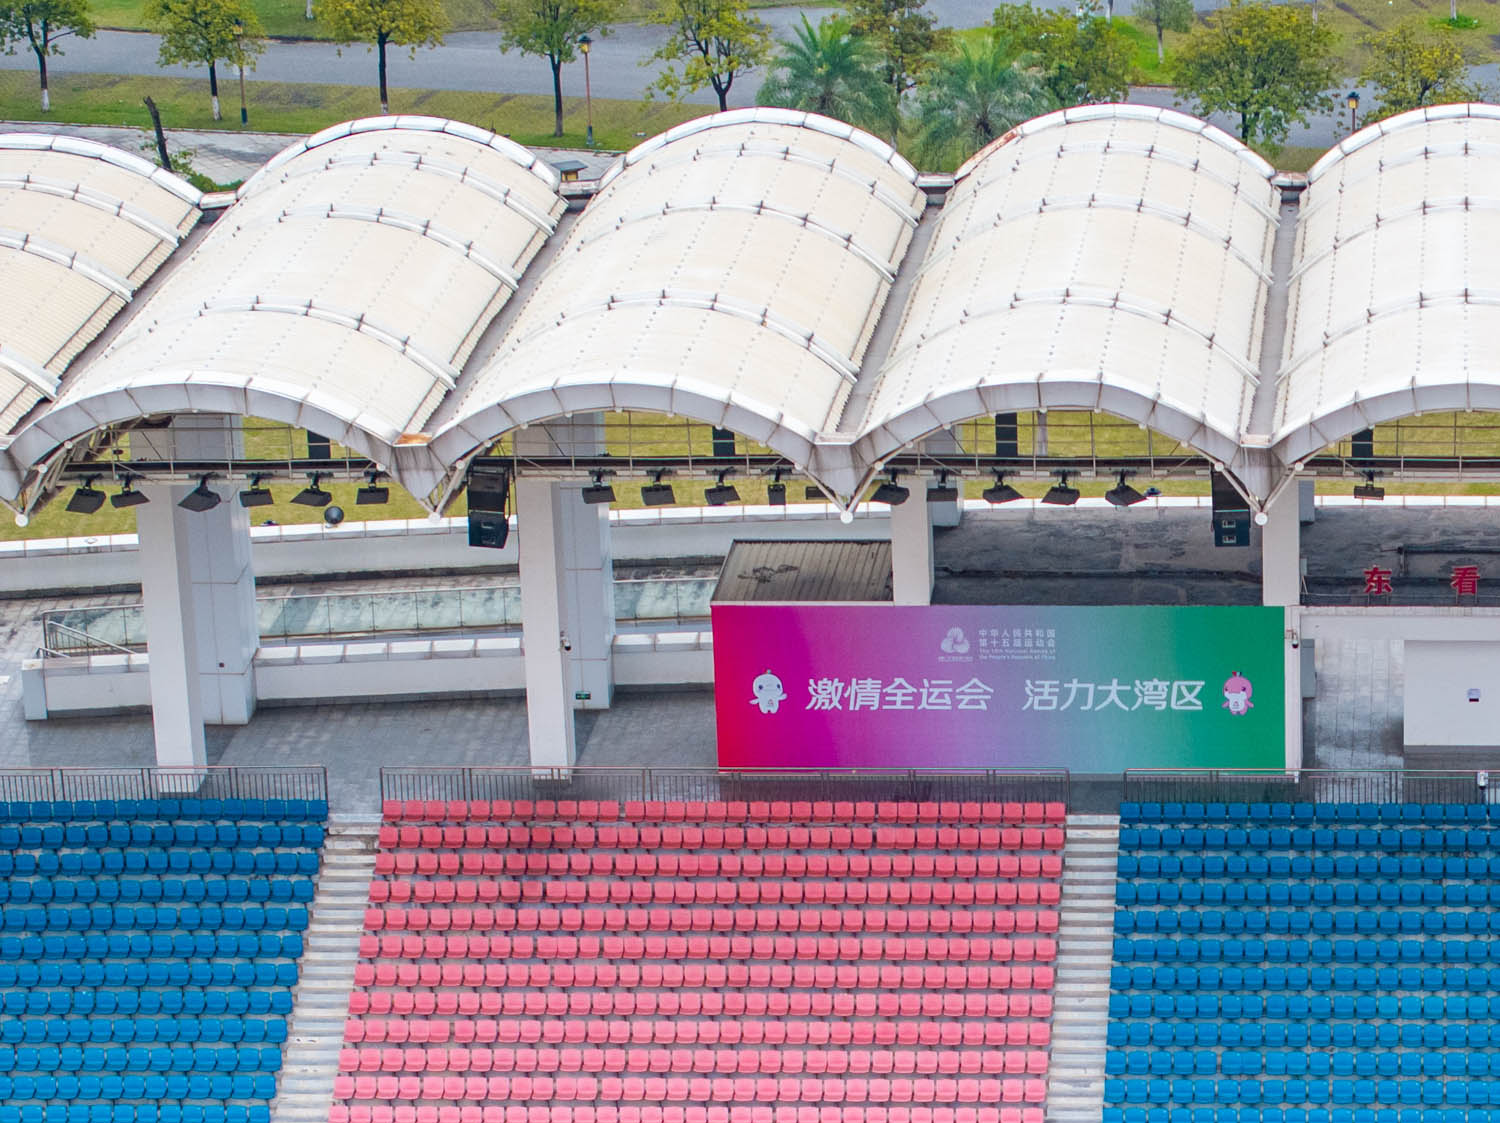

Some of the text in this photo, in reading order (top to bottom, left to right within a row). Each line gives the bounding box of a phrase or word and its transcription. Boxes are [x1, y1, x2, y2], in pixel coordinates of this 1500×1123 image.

[805, 677, 1206, 711] 激情全运会 活力大湾区
